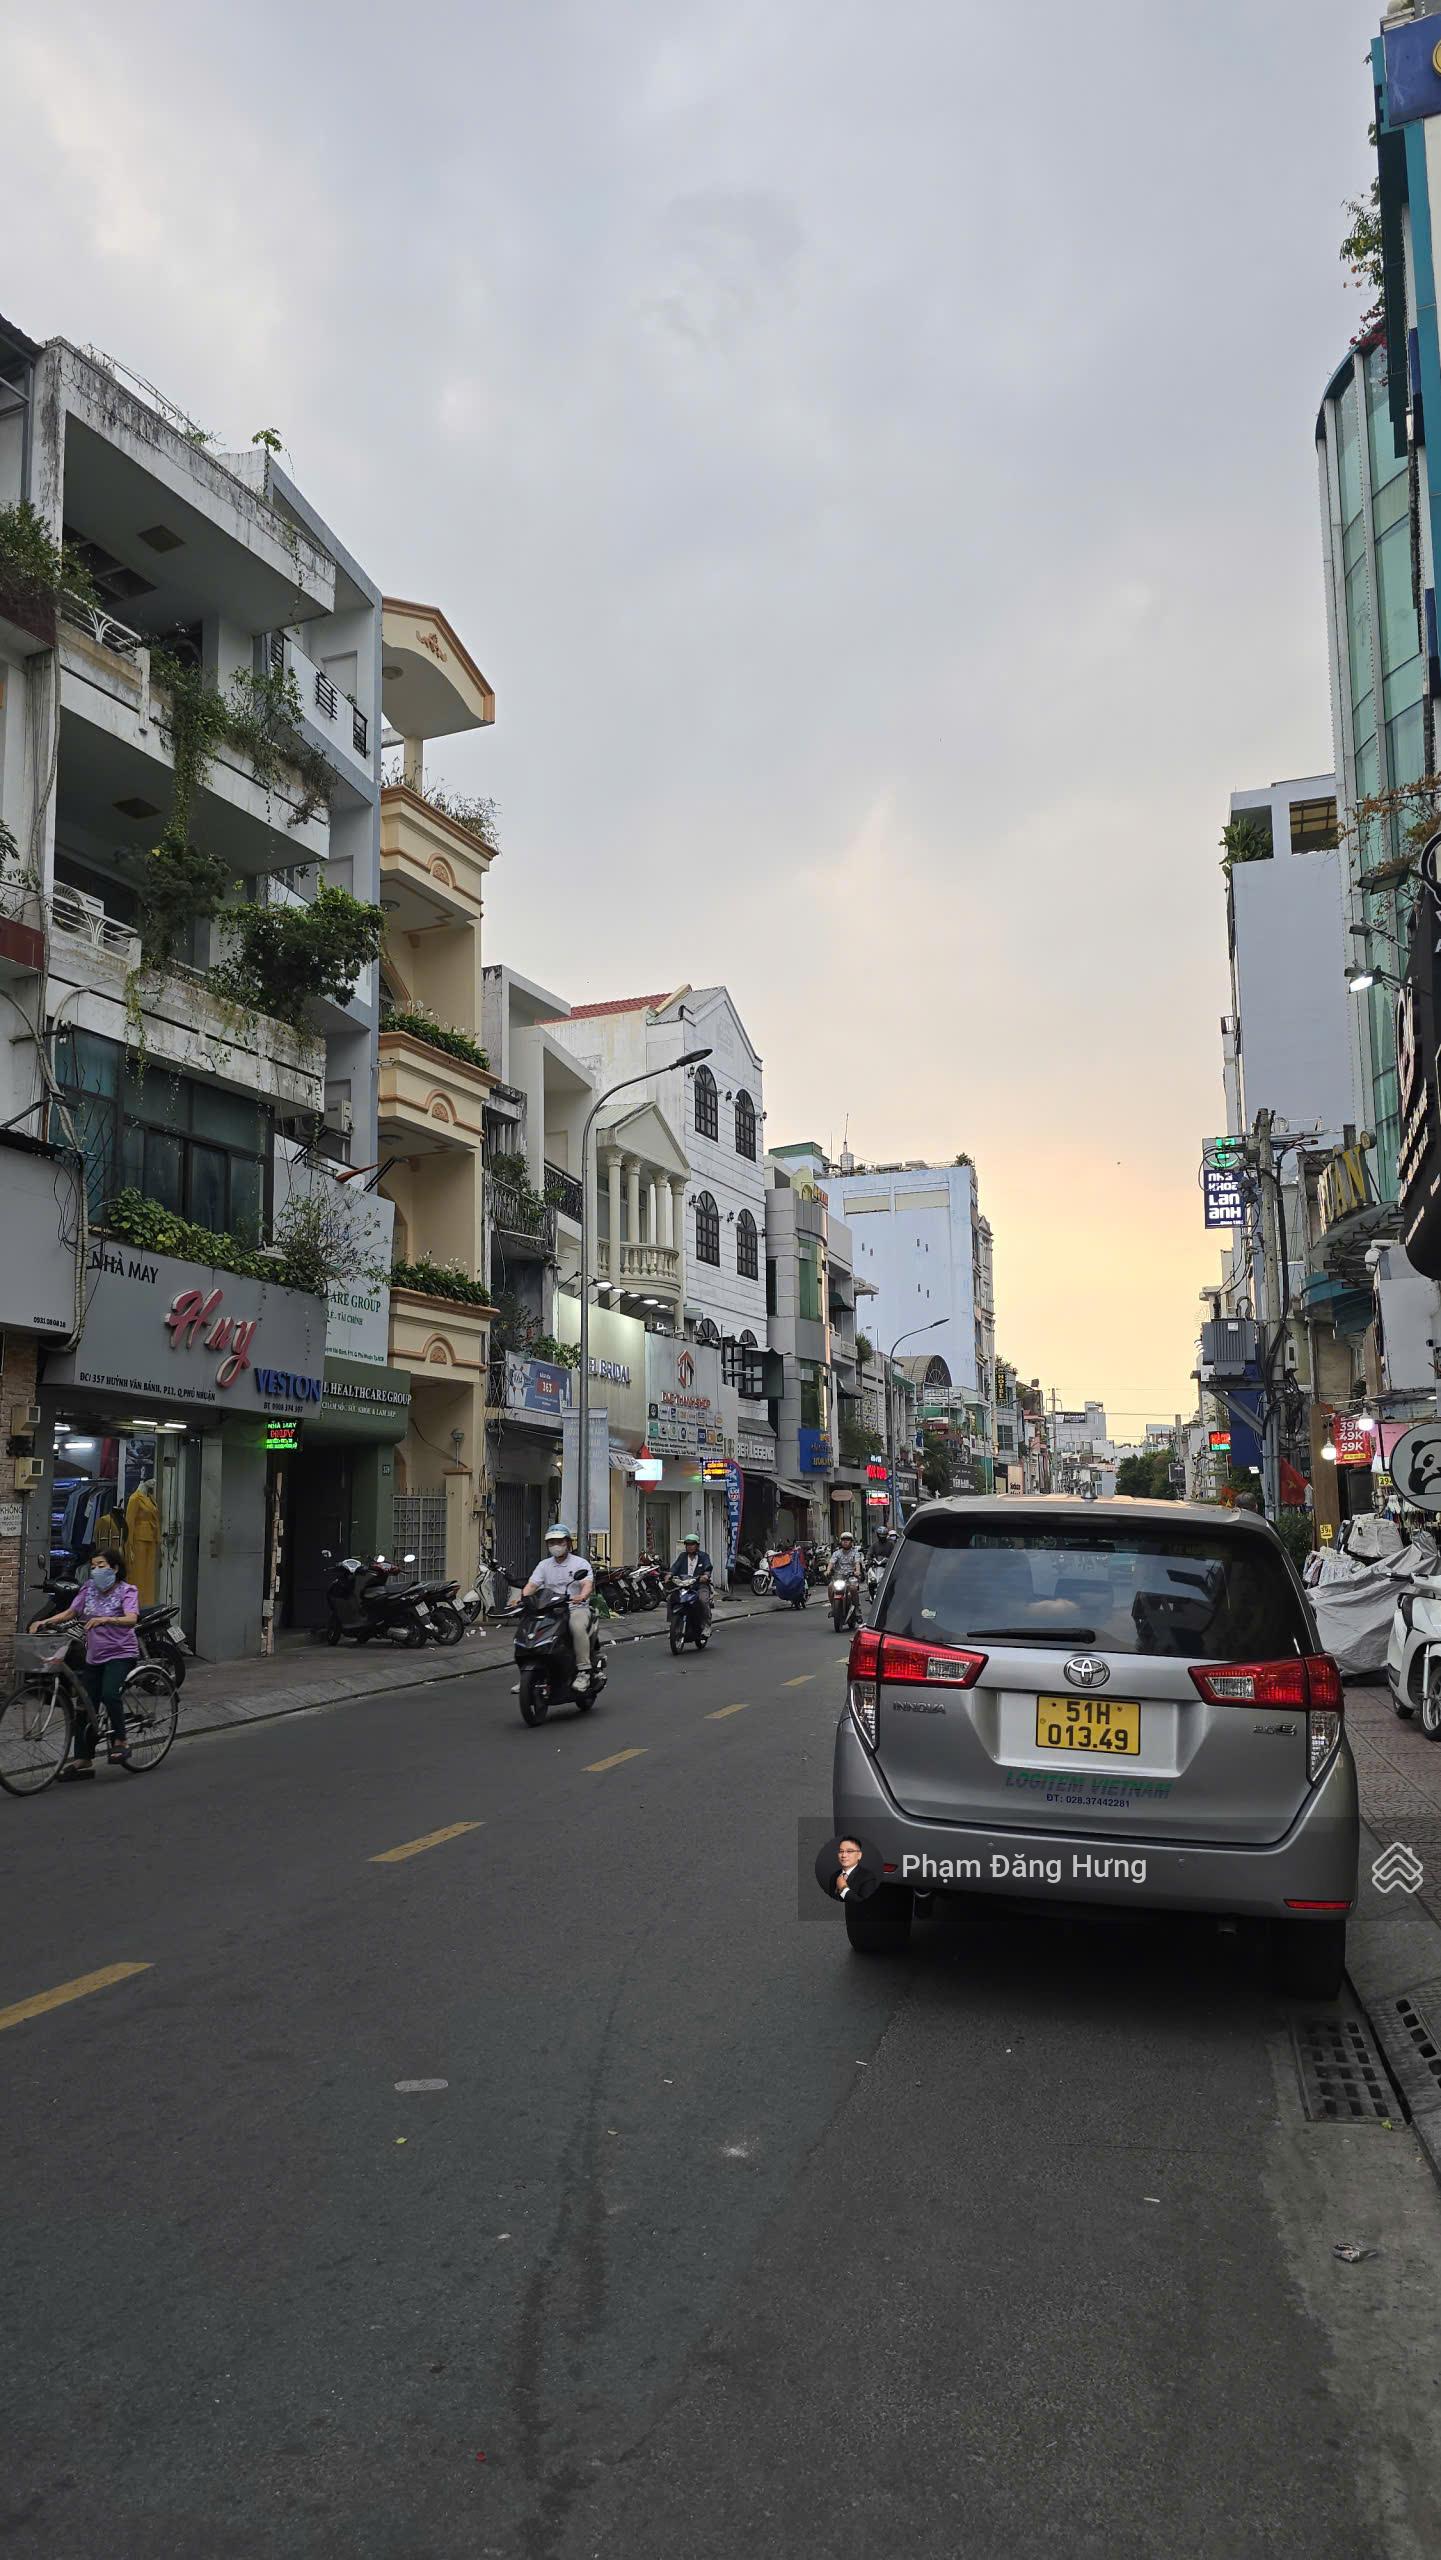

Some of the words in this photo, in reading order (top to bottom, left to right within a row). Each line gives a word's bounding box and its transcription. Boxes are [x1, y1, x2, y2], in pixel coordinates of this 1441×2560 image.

[91, 1250, 125, 1276] NHÀ
[128, 1261, 159, 1284] MAY
[351, 1295, 381, 1313] GROUP
[165, 1288, 258, 1388] Huy
[93, 1374, 105, 1385] 357
[599, 1359, 631, 1383] BRIDAL
[254, 1367, 321, 1404] VESTON
[330, 1382, 387, 1402] HEALTHCARE
[387, 1390, 412, 1405] GROUP
[1340, 1431, 1364, 1441] 49K
[1340, 1441, 1364, 1452] 59K
[893, 1700, 946, 1715] INNOVA
[1066, 1700, 1110, 1725] 51H
[1047, 1723, 1129, 1751] 013.49
[1006, 1770, 1086, 1794] LOGITEM
[1091, 1777, 1174, 1800] VIETNAM
[1065, 1796, 1131, 1809] 028.37442281
